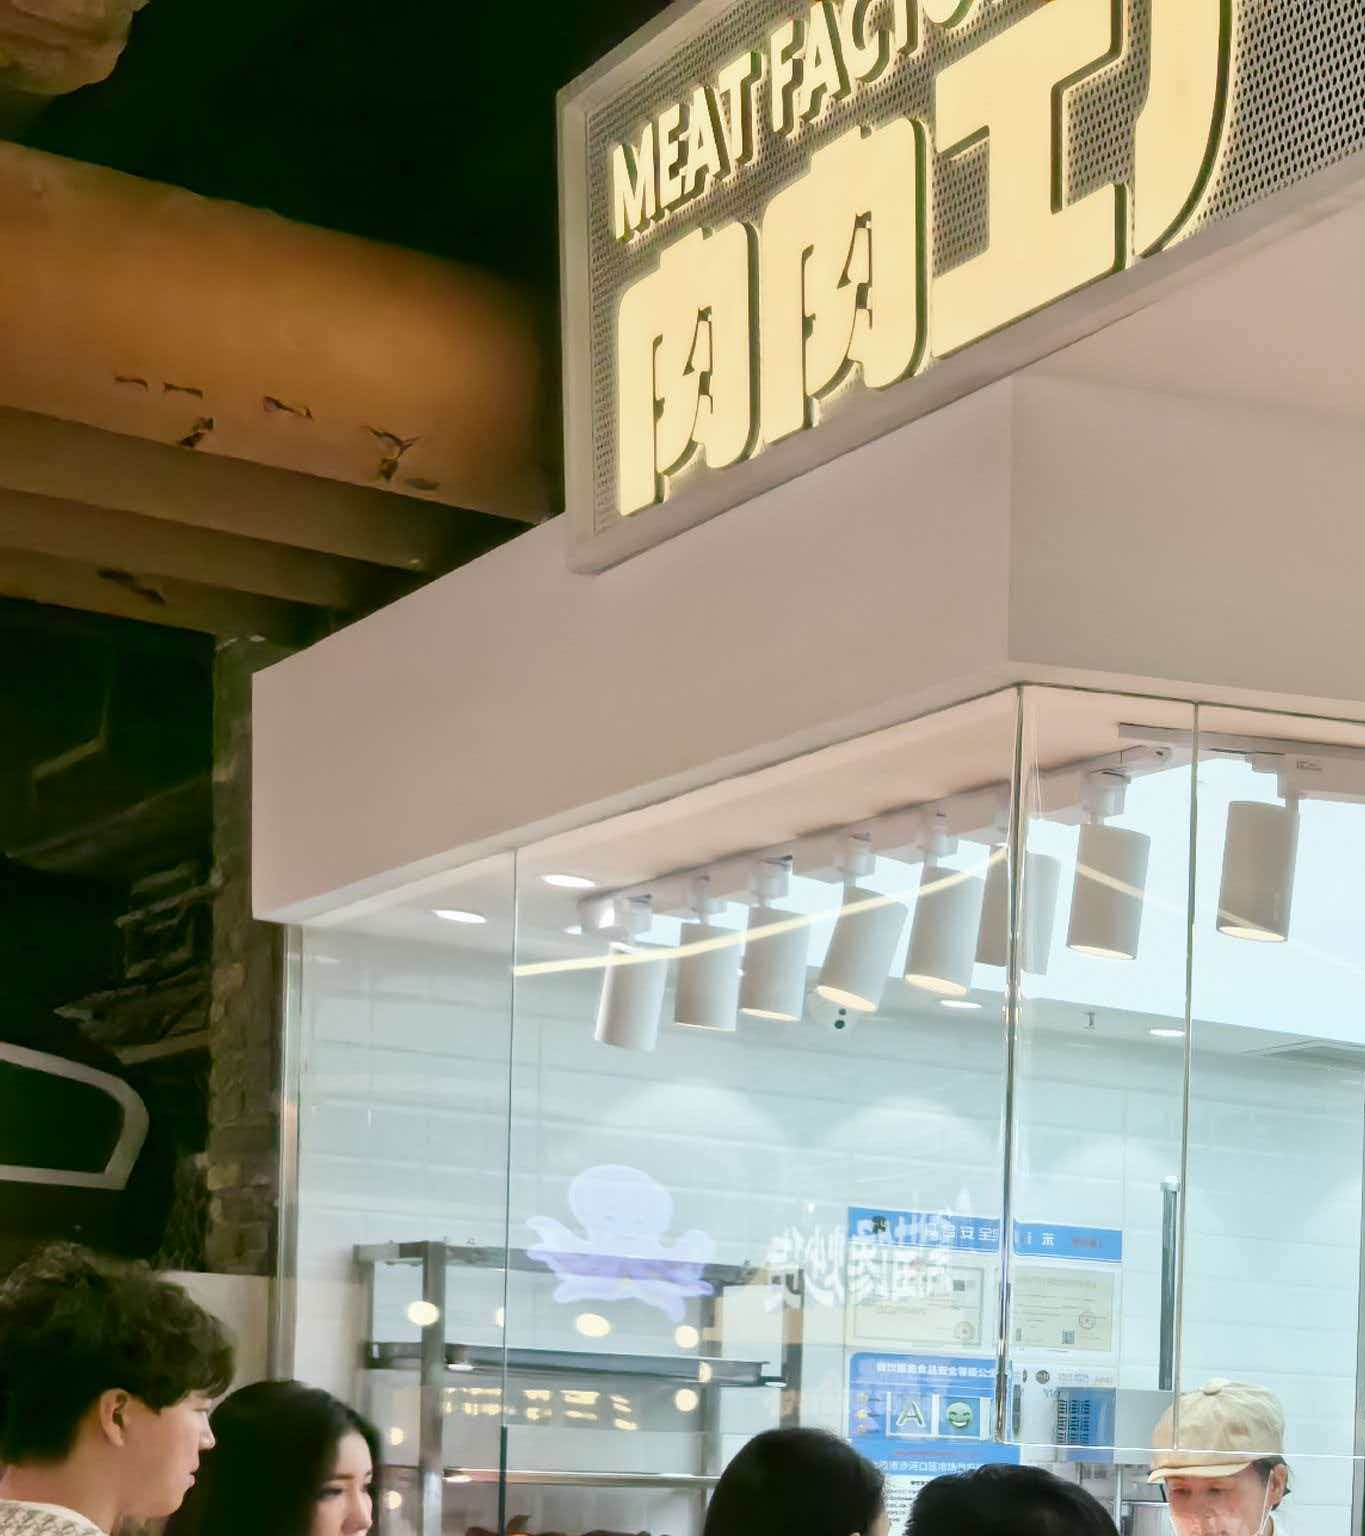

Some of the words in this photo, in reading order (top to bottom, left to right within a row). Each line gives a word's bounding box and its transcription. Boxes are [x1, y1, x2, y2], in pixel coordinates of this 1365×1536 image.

[612, 51, 762, 242] MEAT
[770, 0, 985, 134] FAC
[896, 1400, 927, 1428] A
